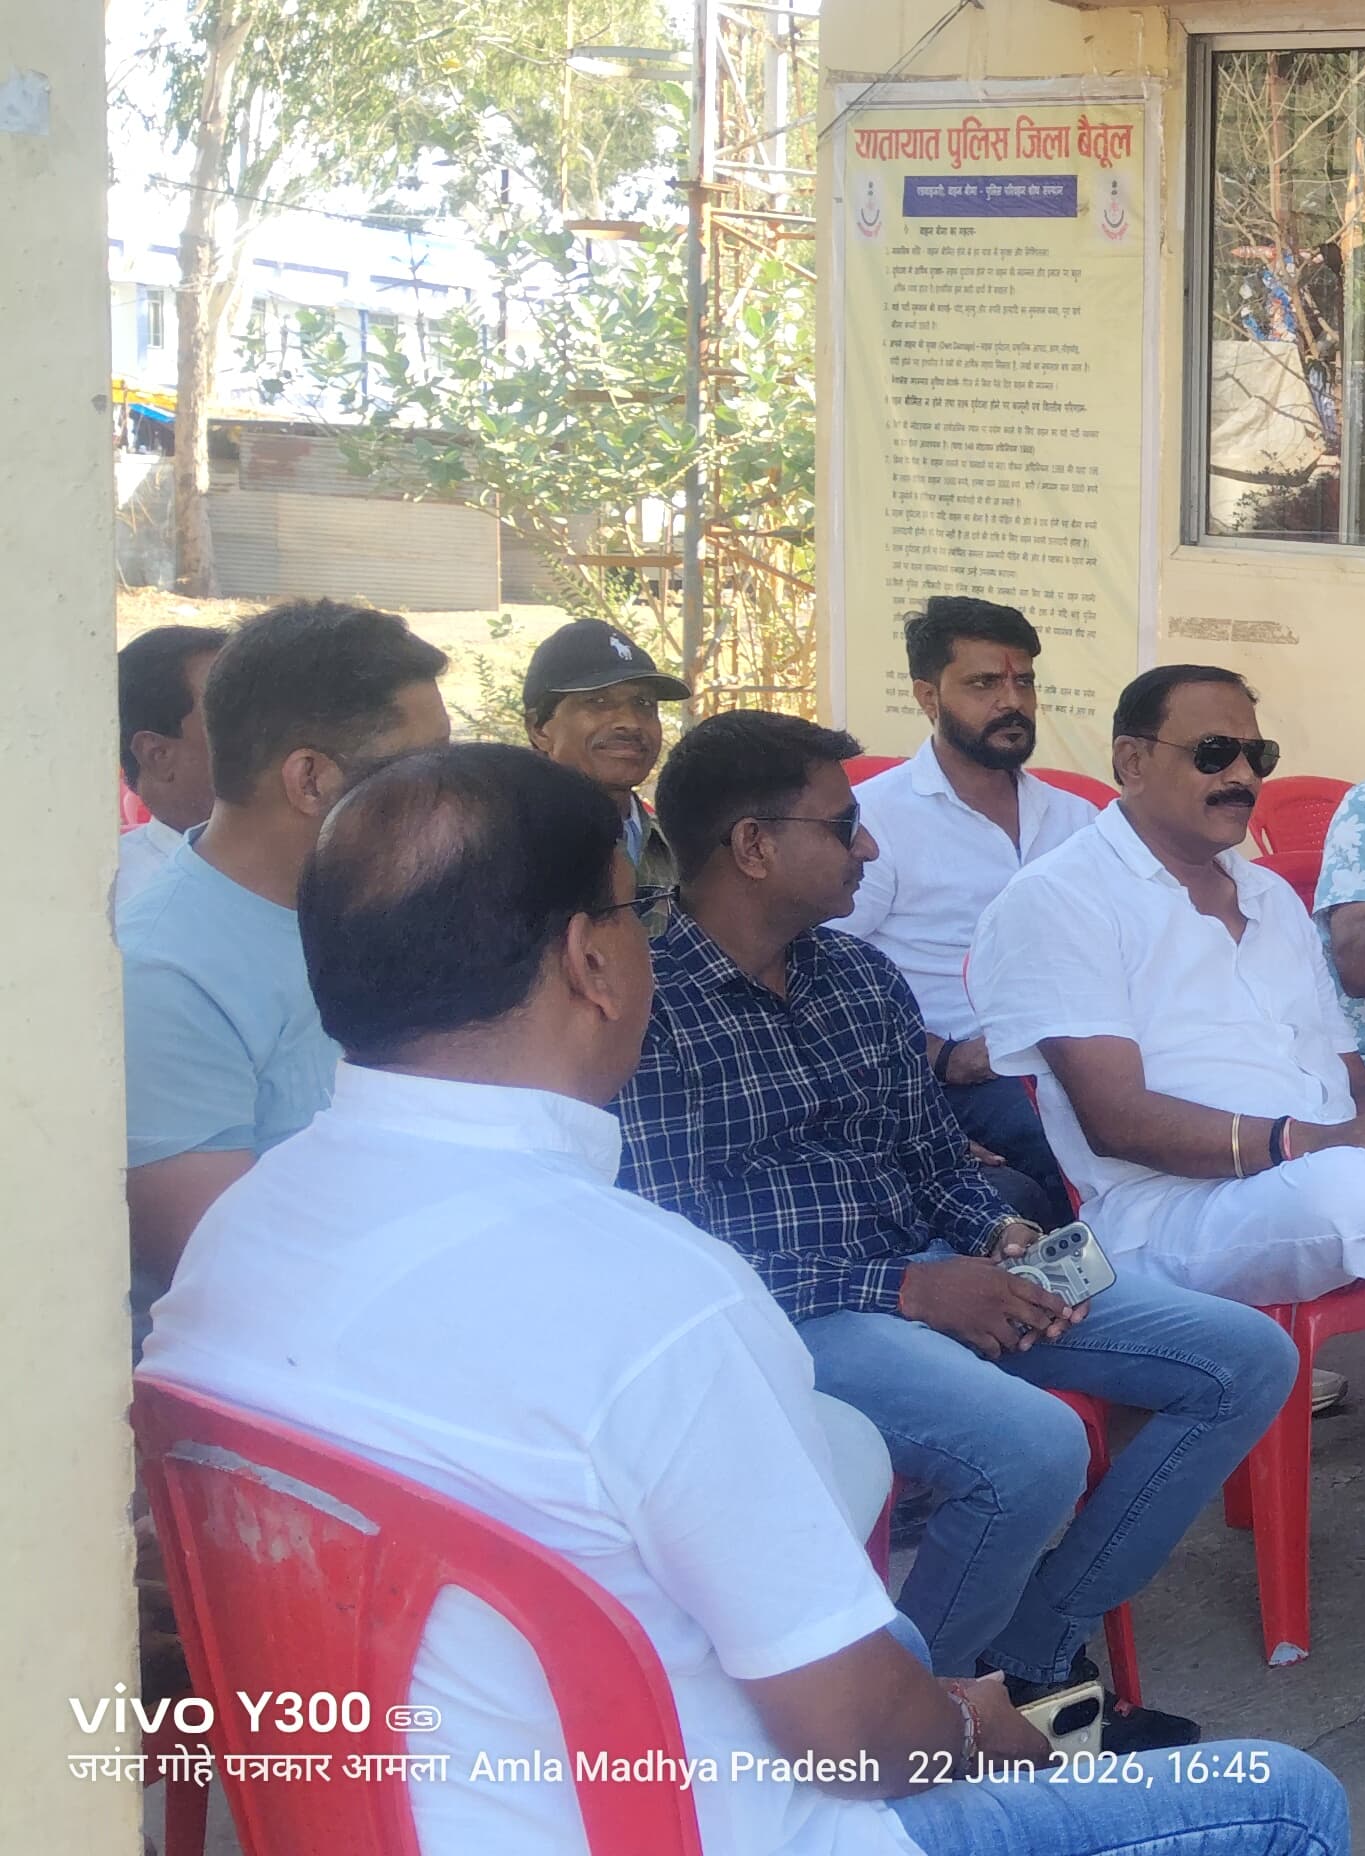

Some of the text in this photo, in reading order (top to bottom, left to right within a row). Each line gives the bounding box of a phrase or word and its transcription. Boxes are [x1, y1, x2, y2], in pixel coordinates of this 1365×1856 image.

[854, 114, 1133, 169] यातायात पुलिस जिला बैतूल
